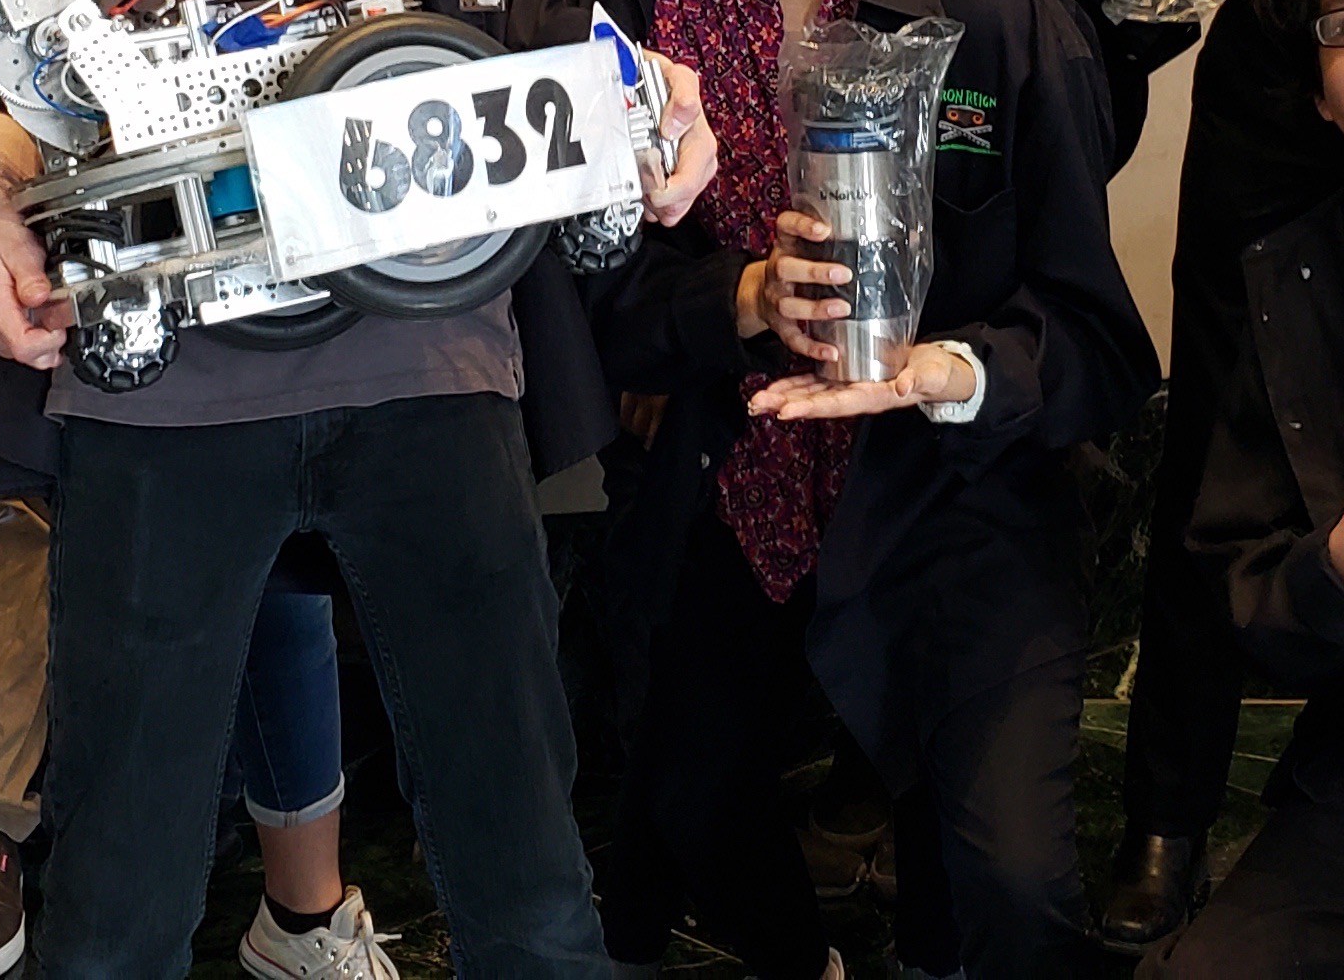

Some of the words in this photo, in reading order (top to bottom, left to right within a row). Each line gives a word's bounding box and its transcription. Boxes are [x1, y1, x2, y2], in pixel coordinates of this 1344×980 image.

[940, 88, 964, 104] RON
[965, 89, 997, 109] REIGN
[339, 77, 588, 214] 6832
